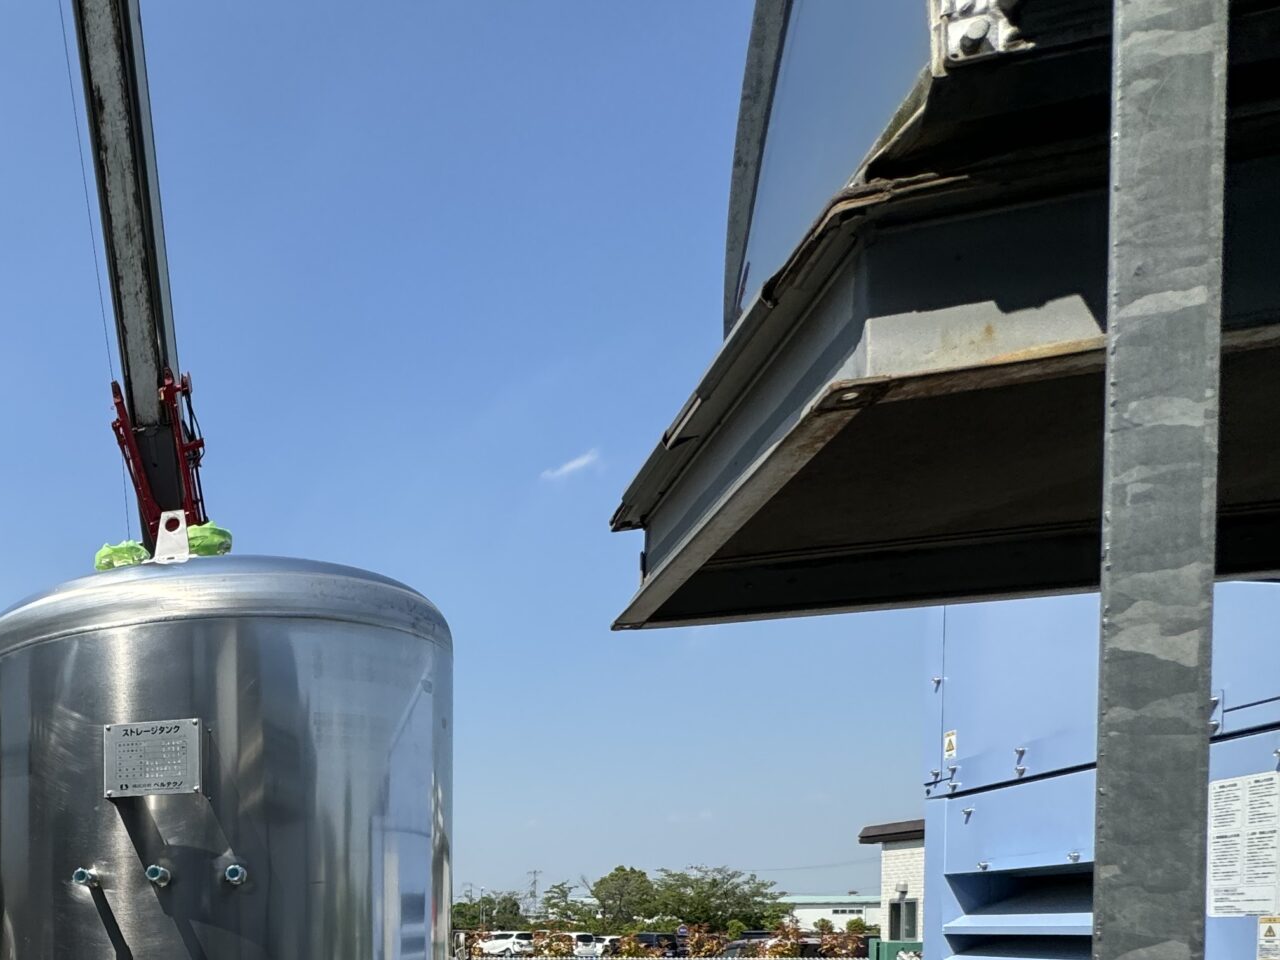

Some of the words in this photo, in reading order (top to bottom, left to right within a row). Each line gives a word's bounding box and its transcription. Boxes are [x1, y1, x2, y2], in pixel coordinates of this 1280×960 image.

[122, 725, 180, 737] ストレージタンク
